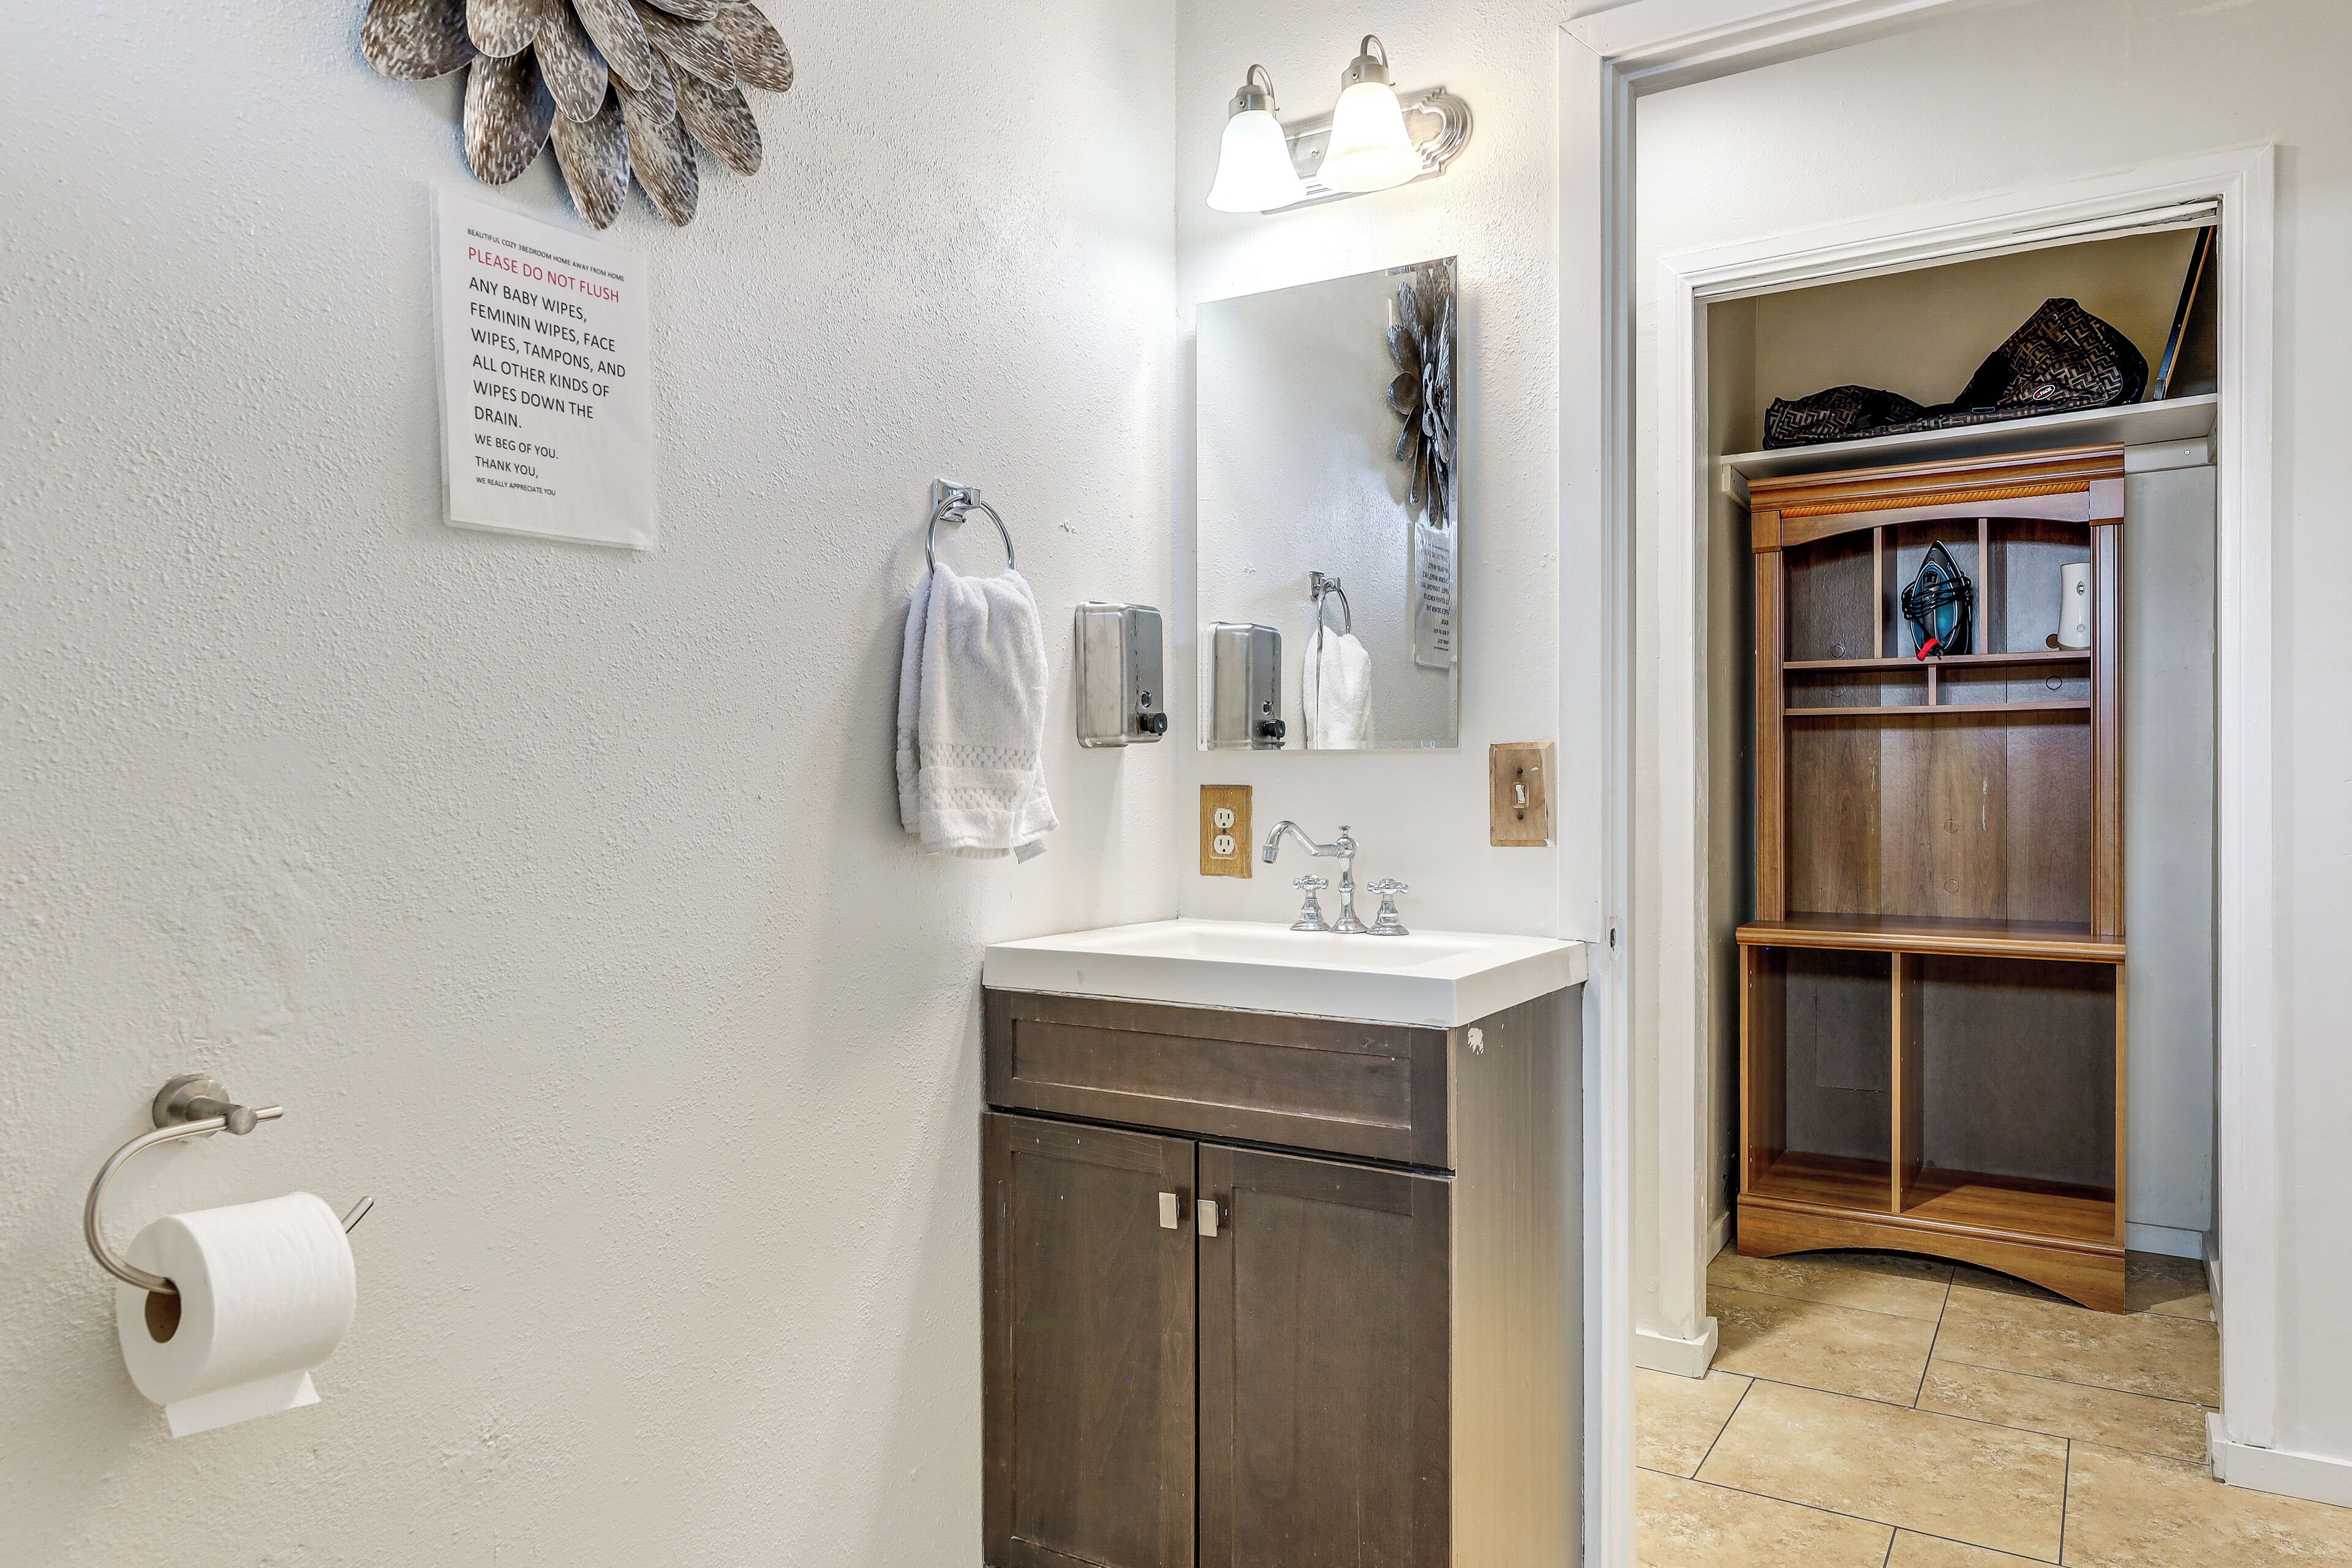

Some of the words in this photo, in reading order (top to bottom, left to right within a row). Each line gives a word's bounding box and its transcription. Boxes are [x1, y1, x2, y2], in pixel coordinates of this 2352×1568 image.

[467, 228, 500, 244] BEAUTIFUL
[502, 239, 517, 249] COZY
[518, 244, 552, 260] 3BEDROOM
[553, 255, 571, 266] HOME
[572, 262, 589, 271] AWAY
[590, 266, 606, 276] FROM
[608, 272, 625, 282] HOME
[469, 247, 518, 273] PLEASE
[523, 263, 543, 280] DO
[548, 271, 576, 290] NOT
[580, 281, 619, 303] FLUSH
[469, 277, 498, 295] ANY
[503, 286, 538, 307] BABY
[541, 296, 587, 323] WIPES,
[470, 302, 530, 330] FEMININ
[535, 319, 579, 345] WIPES,
[584, 333, 616, 352] FACE
[471, 328, 519, 354] WIPES,
[523, 341, 594, 373] TAMPONS,
[597, 361, 625, 377] AND
[472, 355, 497, 372] ALL
[501, 361, 545, 383] OTHER
[550, 373, 588, 393] KINDS
[592, 383, 609, 398] OF
[473, 380, 516, 402] WIPES
[521, 391, 565, 413] DOWN
[568, 402, 594, 419] THE
[475, 406, 522, 428] DRAIN.
[475, 433, 492, 446] WE
[496, 437, 515, 451] BEG
[519, 442, 532, 453] OF
[535, 445, 559, 459] YOU.
[475, 456, 511, 472] THANK
[514, 464, 538, 478] YOU,
[488, 479, 508, 488] REALLY
[509, 483, 543, 494] APPRECIATE
